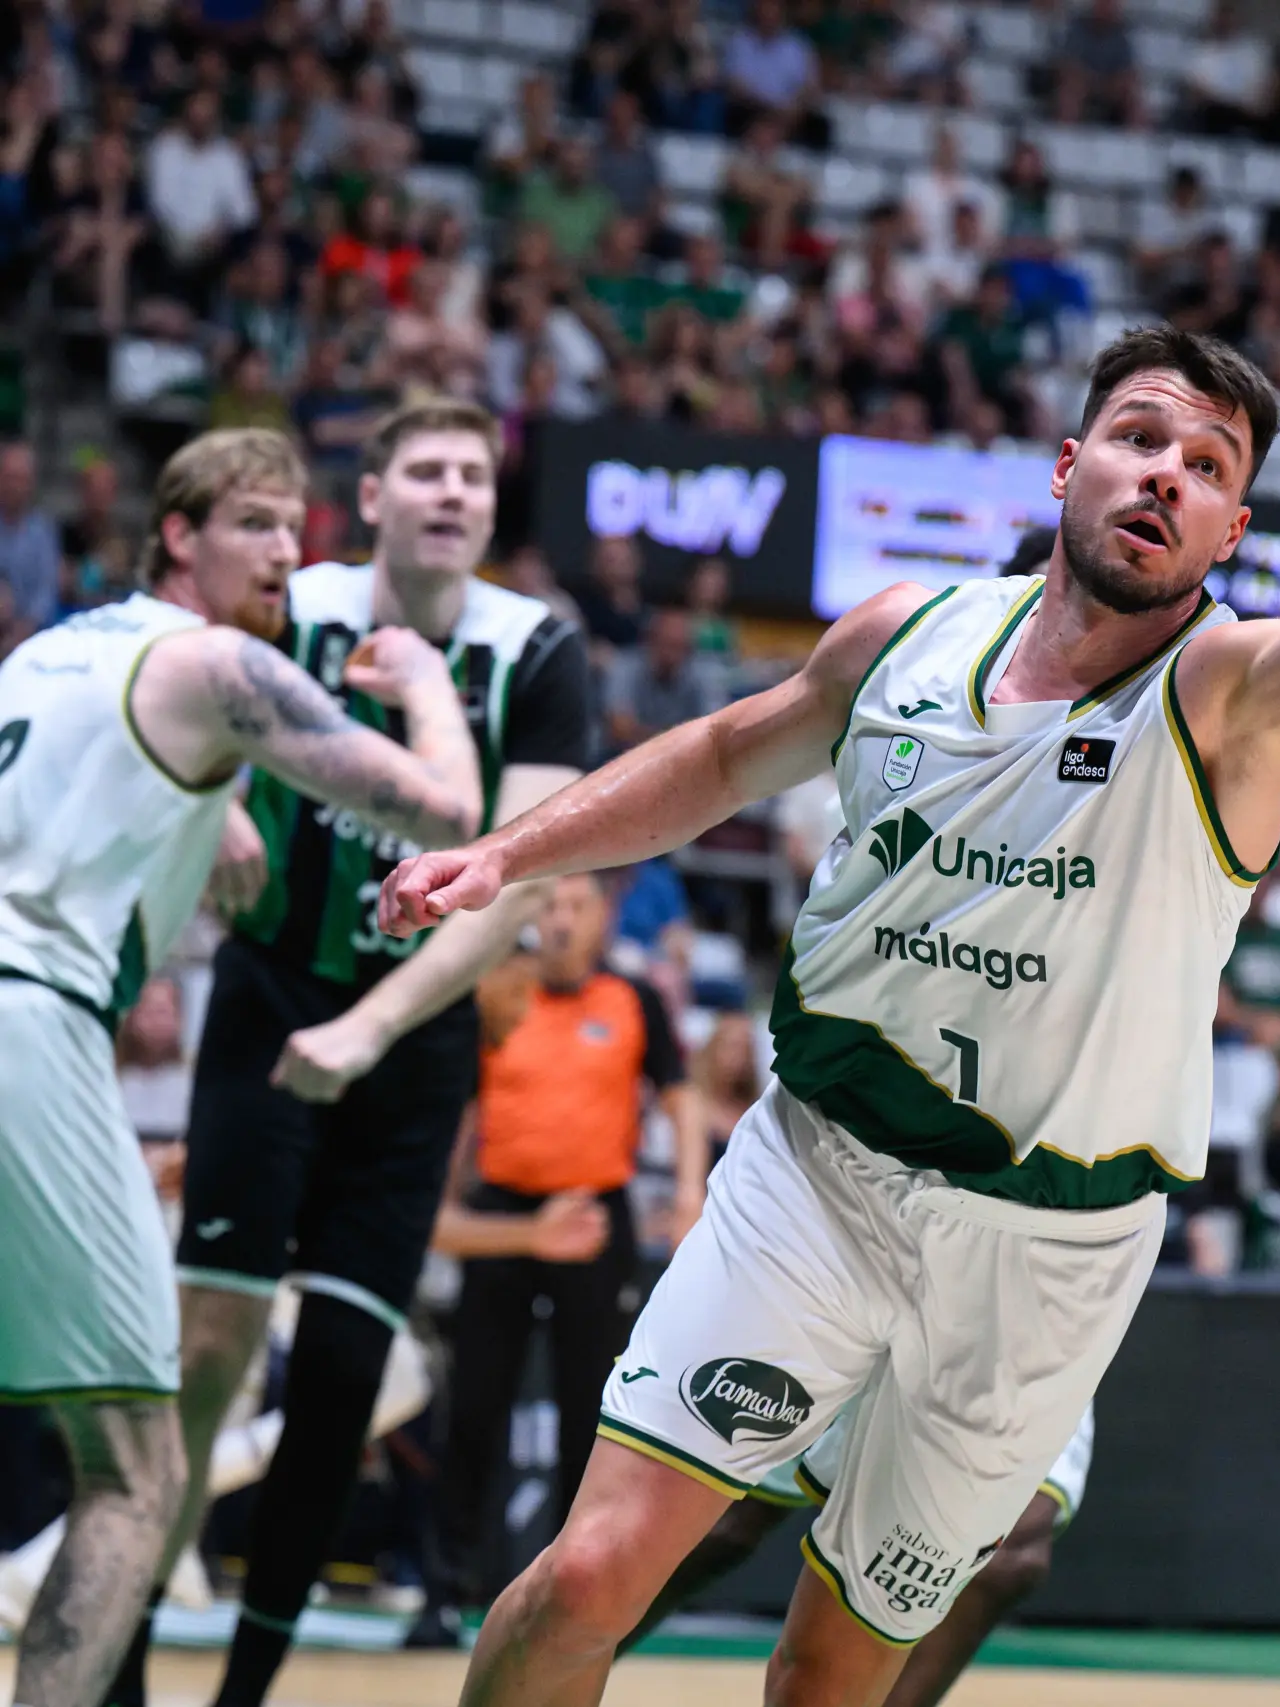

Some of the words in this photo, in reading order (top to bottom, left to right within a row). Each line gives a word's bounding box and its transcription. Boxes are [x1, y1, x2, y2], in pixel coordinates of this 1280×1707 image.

[1062, 763, 1106, 777] endesa
[1064, 749, 1085, 764] liga
[932, 835, 1096, 900] Unicaja
[874, 922, 1047, 990] málaga
[938, 1026, 980, 1104] 1
[692, 1360, 804, 1425] famadsa
[882, 1537, 893, 1551] a
[892, 1523, 949, 1560] sabor
[863, 1551, 940, 1613] laga
